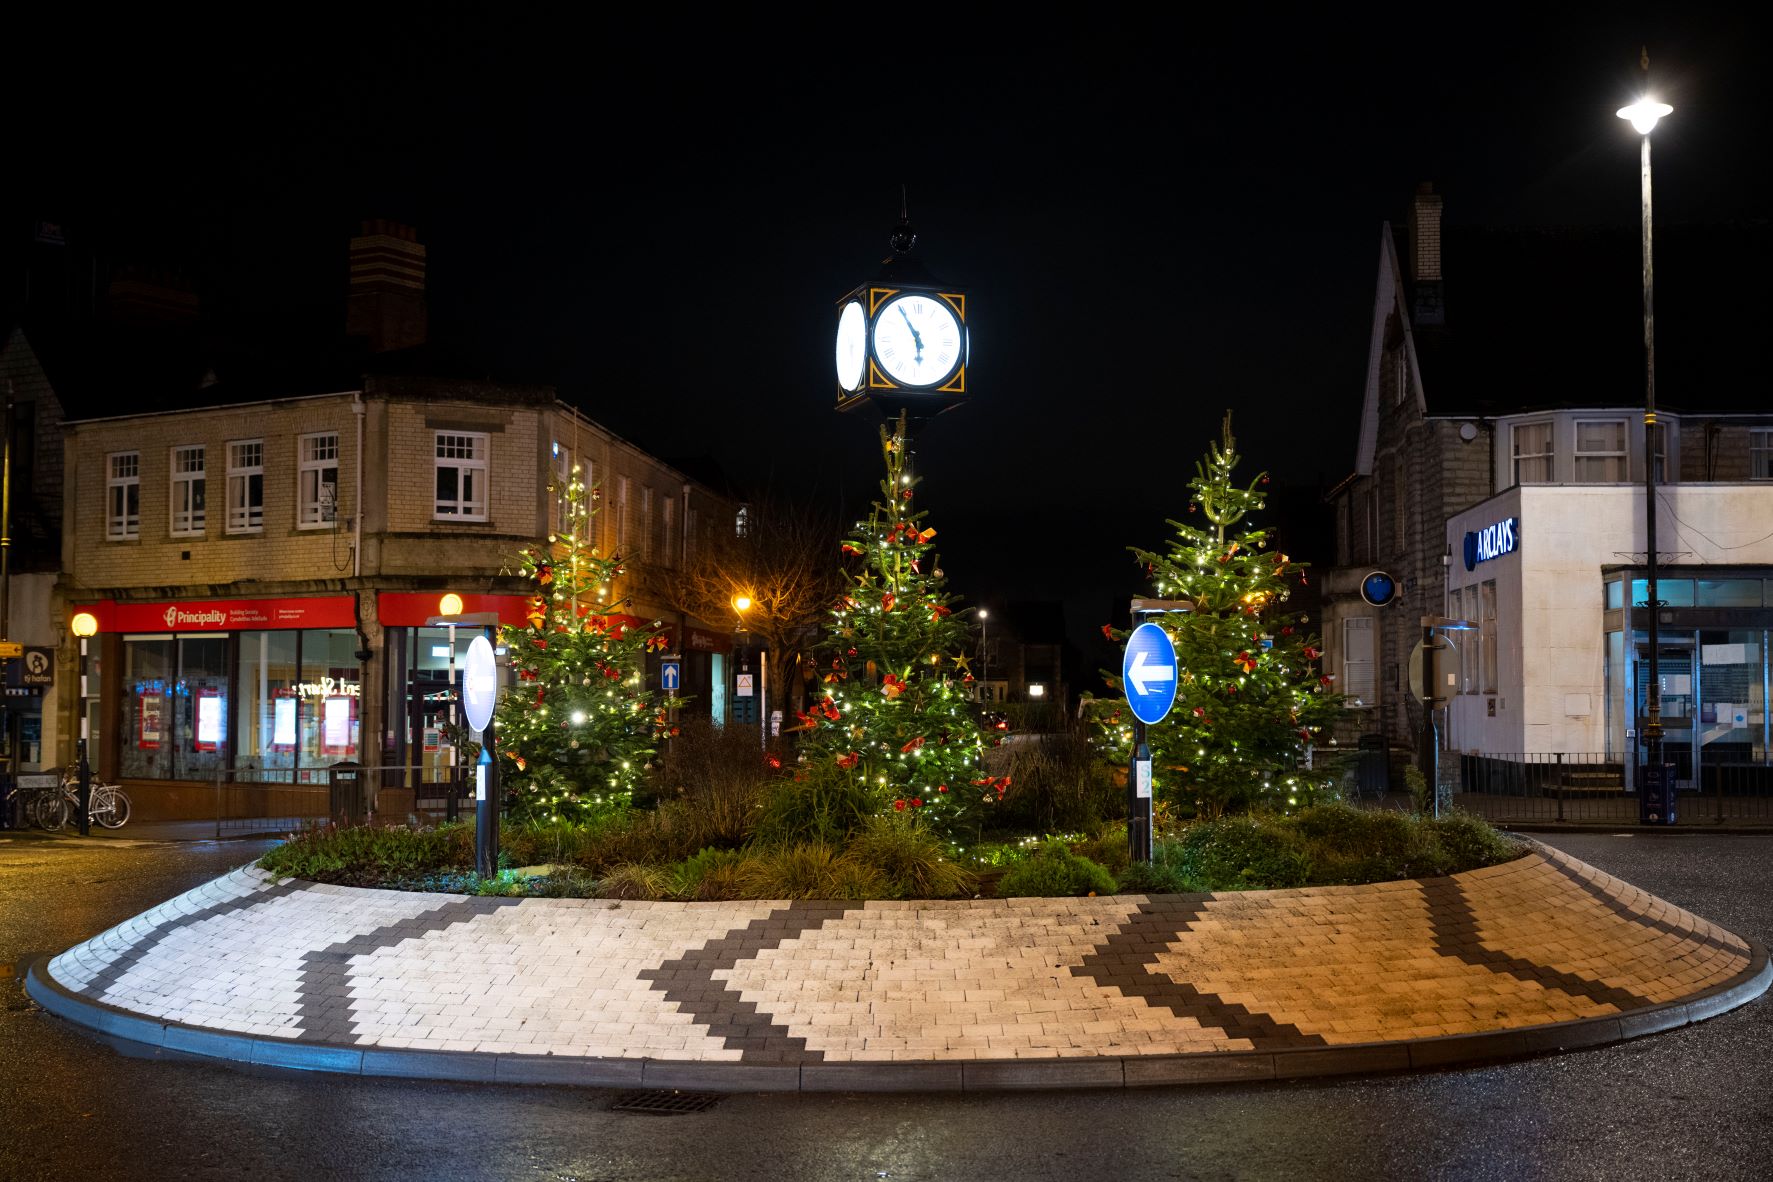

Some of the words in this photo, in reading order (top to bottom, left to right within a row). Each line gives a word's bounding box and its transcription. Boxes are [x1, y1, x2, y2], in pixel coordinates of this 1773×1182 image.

[1473, 517, 1513, 562] ARCLAYS
[178, 609, 226, 626] Principality
[32, 673, 51, 683] hafan
